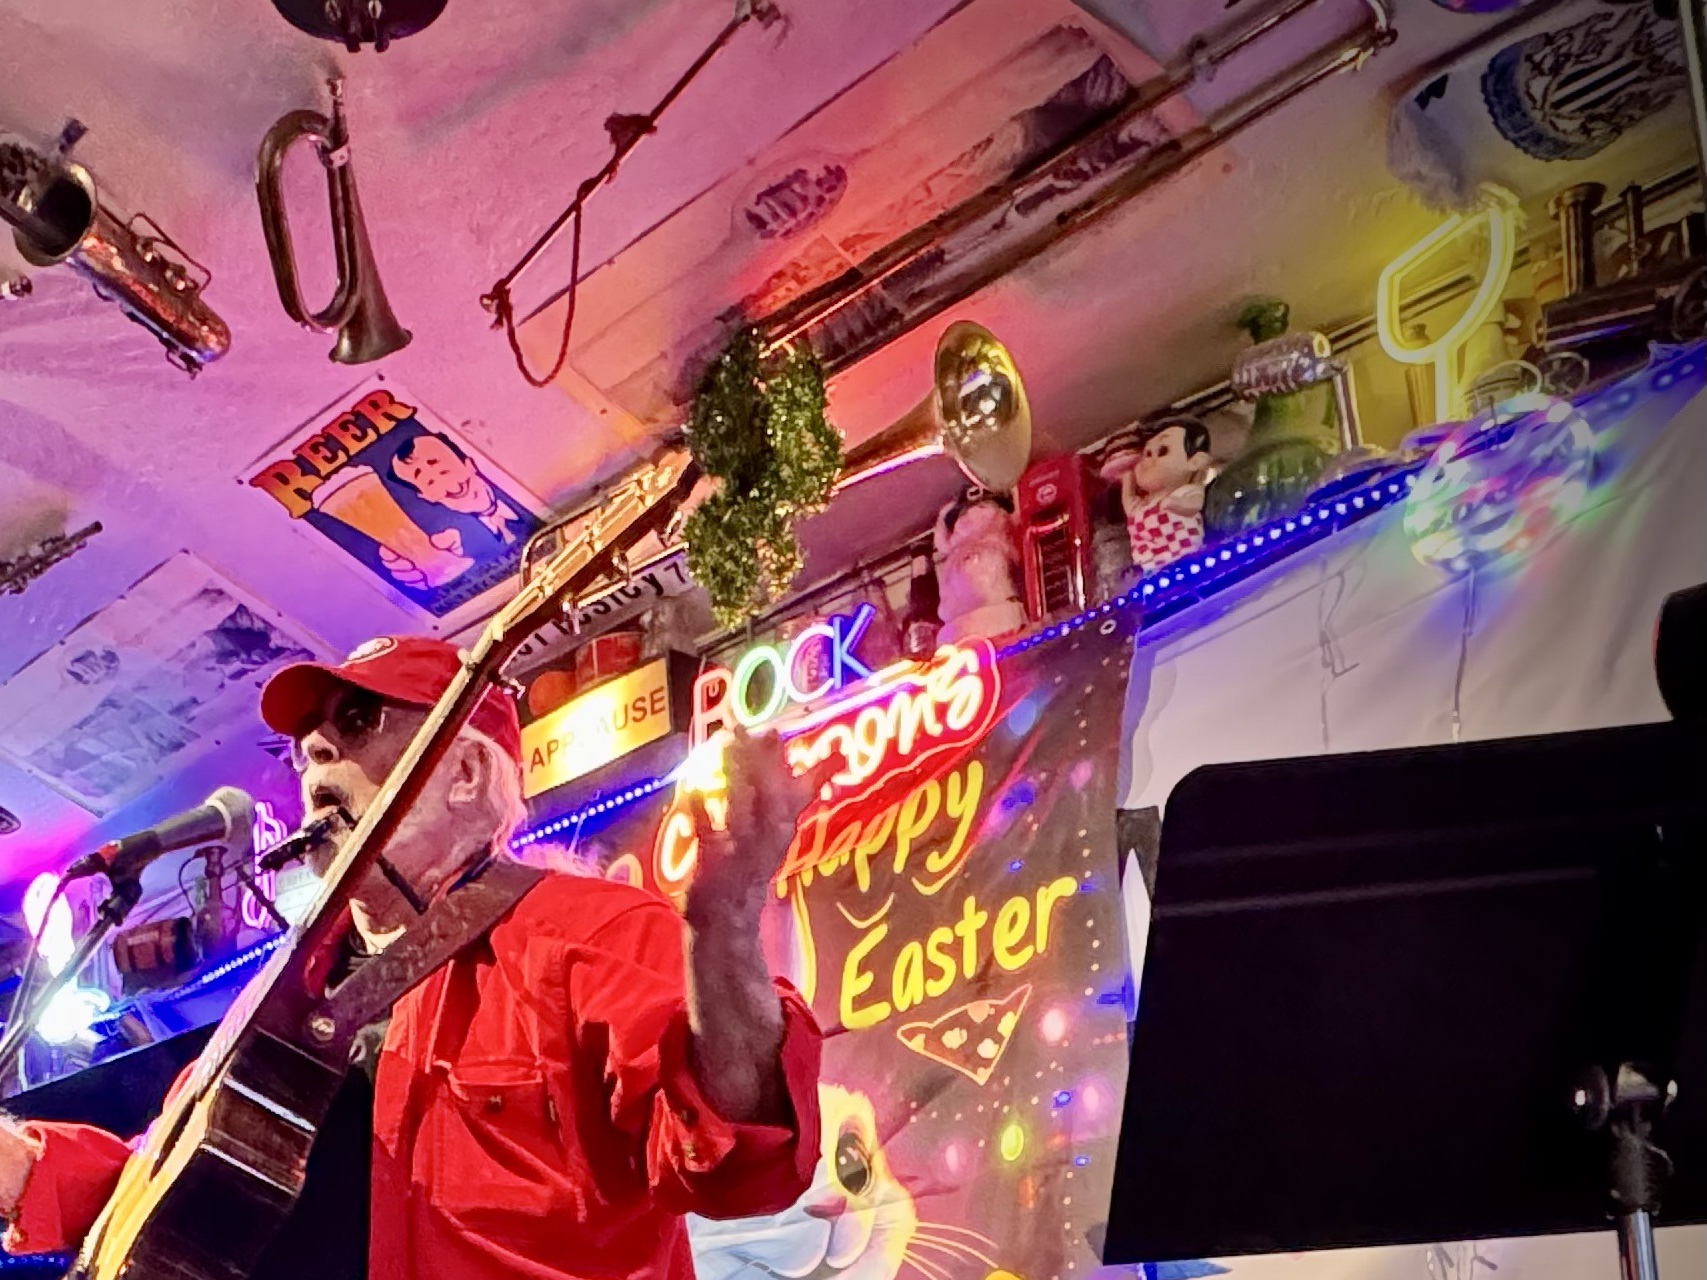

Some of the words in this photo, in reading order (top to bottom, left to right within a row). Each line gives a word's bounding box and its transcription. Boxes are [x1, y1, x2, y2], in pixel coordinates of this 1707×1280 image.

[248, 389, 418, 520] BEER
[529, 685, 667, 774] APPAUSE
[840, 875, 1078, 1030] Easter
